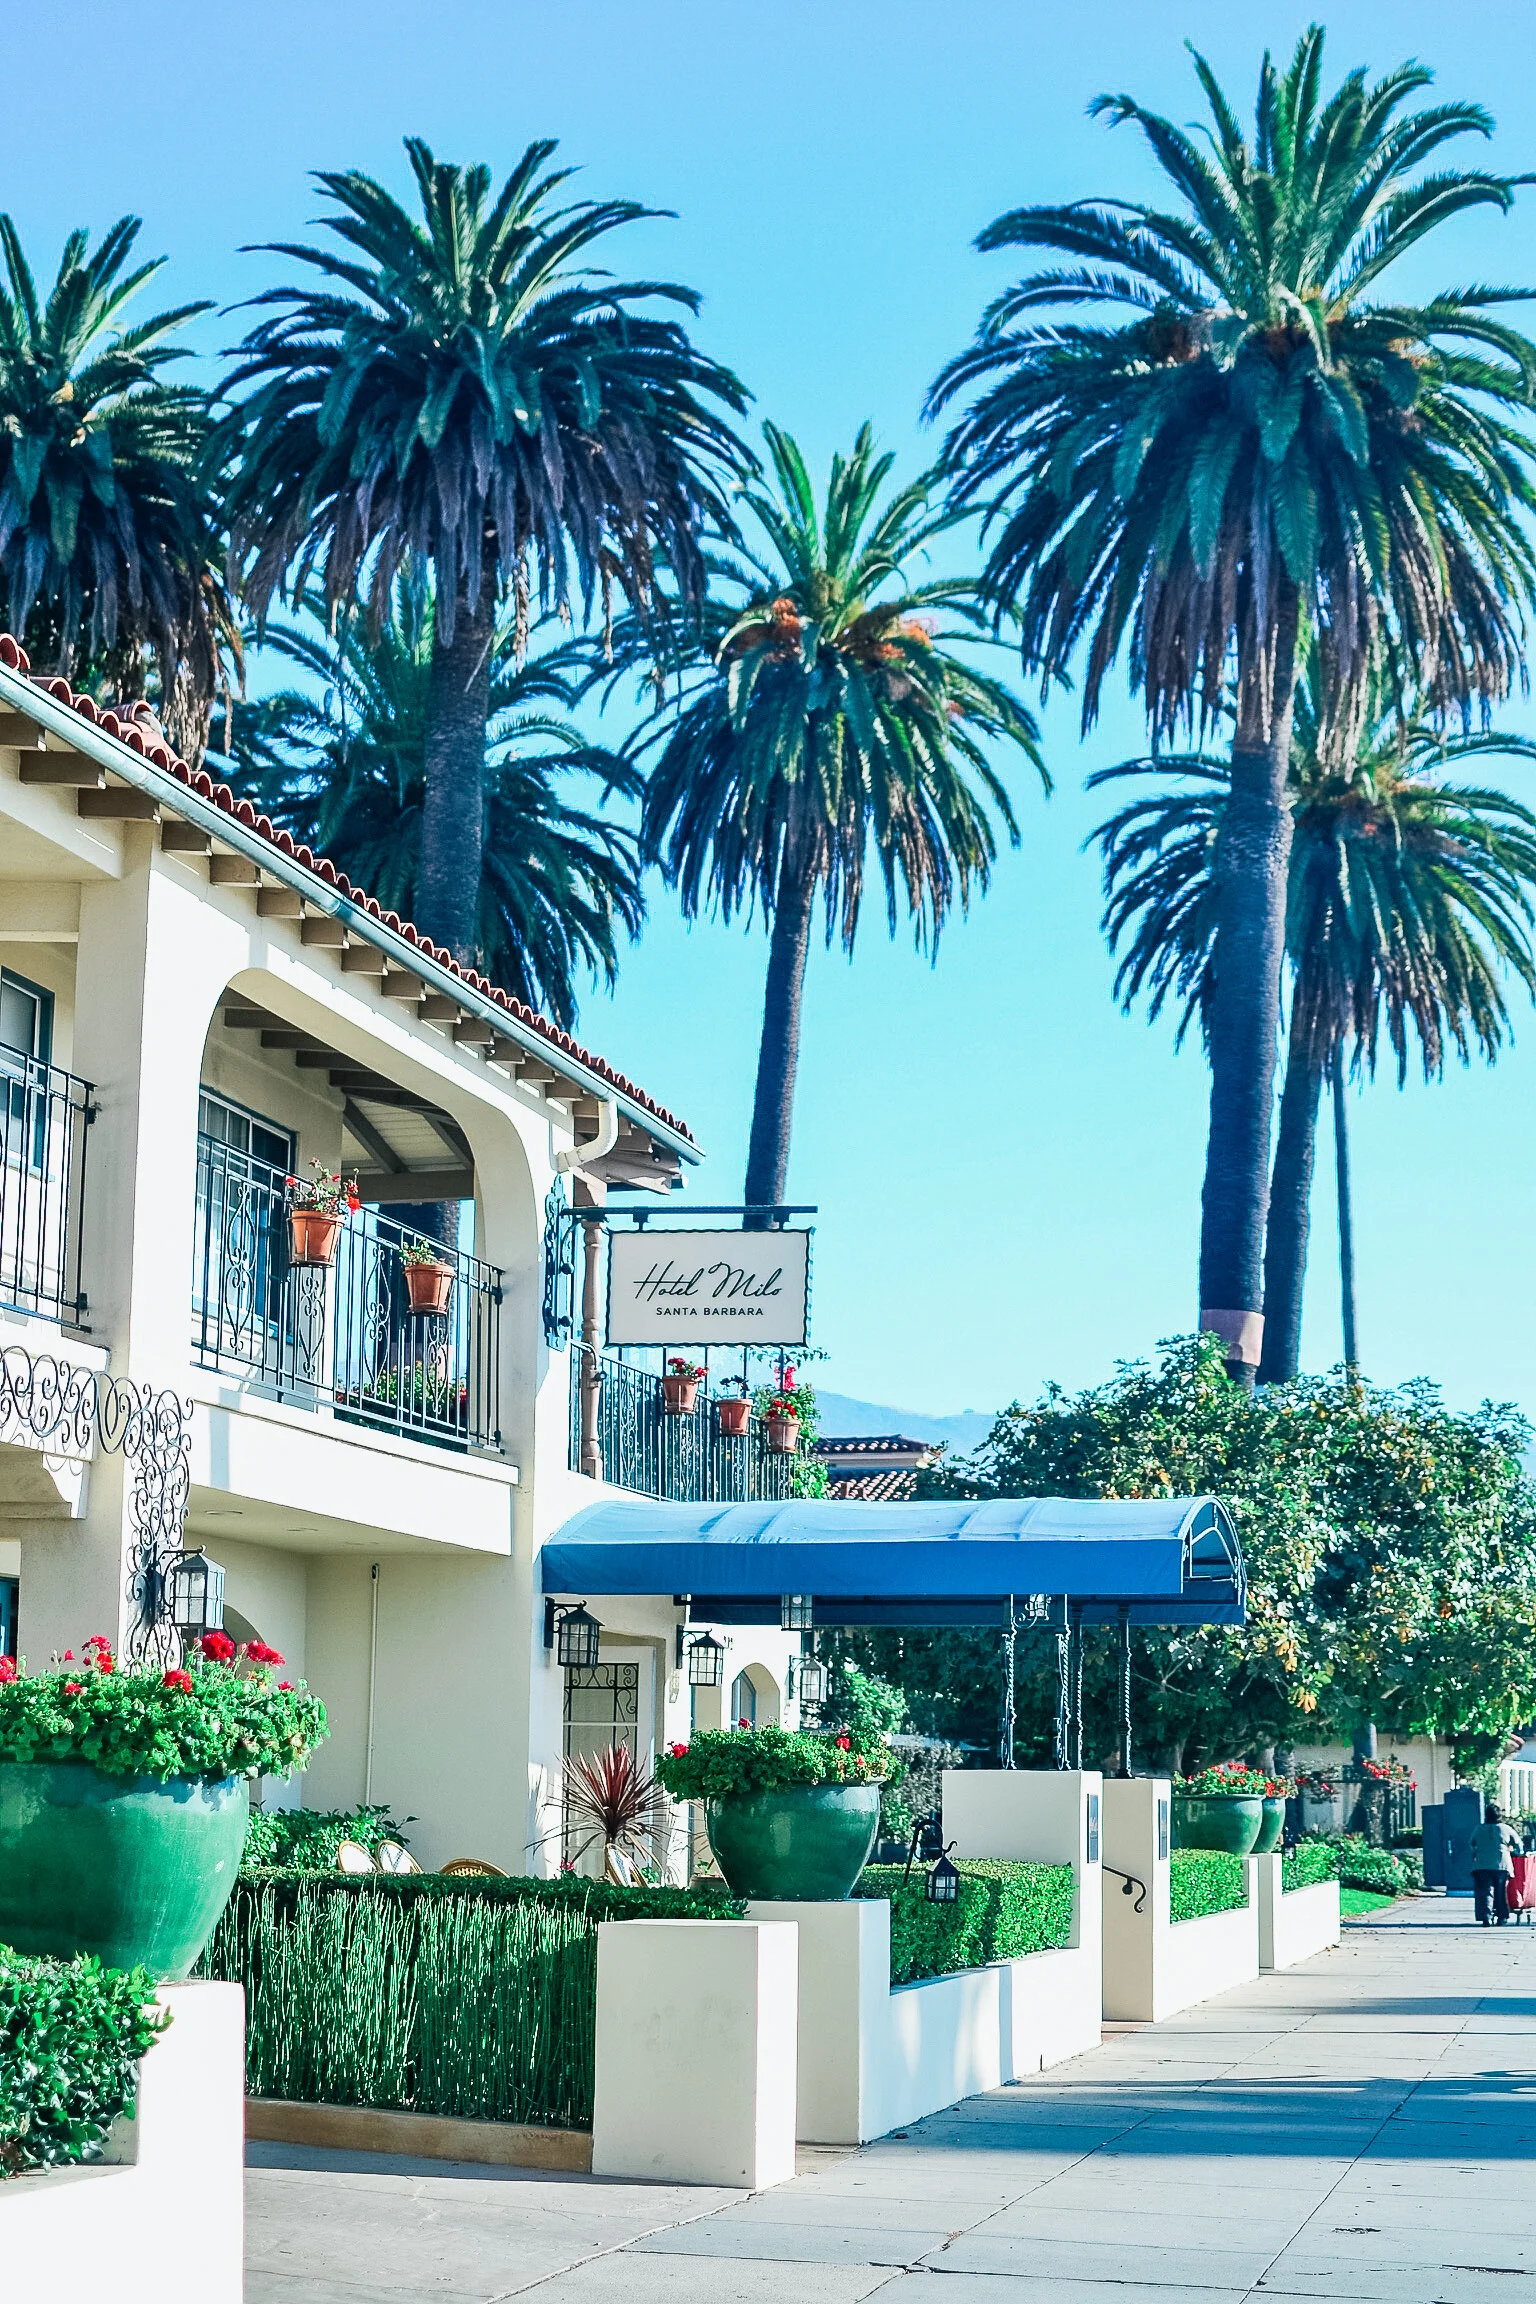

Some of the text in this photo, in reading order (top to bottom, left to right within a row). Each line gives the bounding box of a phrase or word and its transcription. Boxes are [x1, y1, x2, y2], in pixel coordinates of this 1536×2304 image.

[633, 1260, 782, 1301] Hotel Milo
[656, 1307, 763, 1316] SANTA BARBARA
